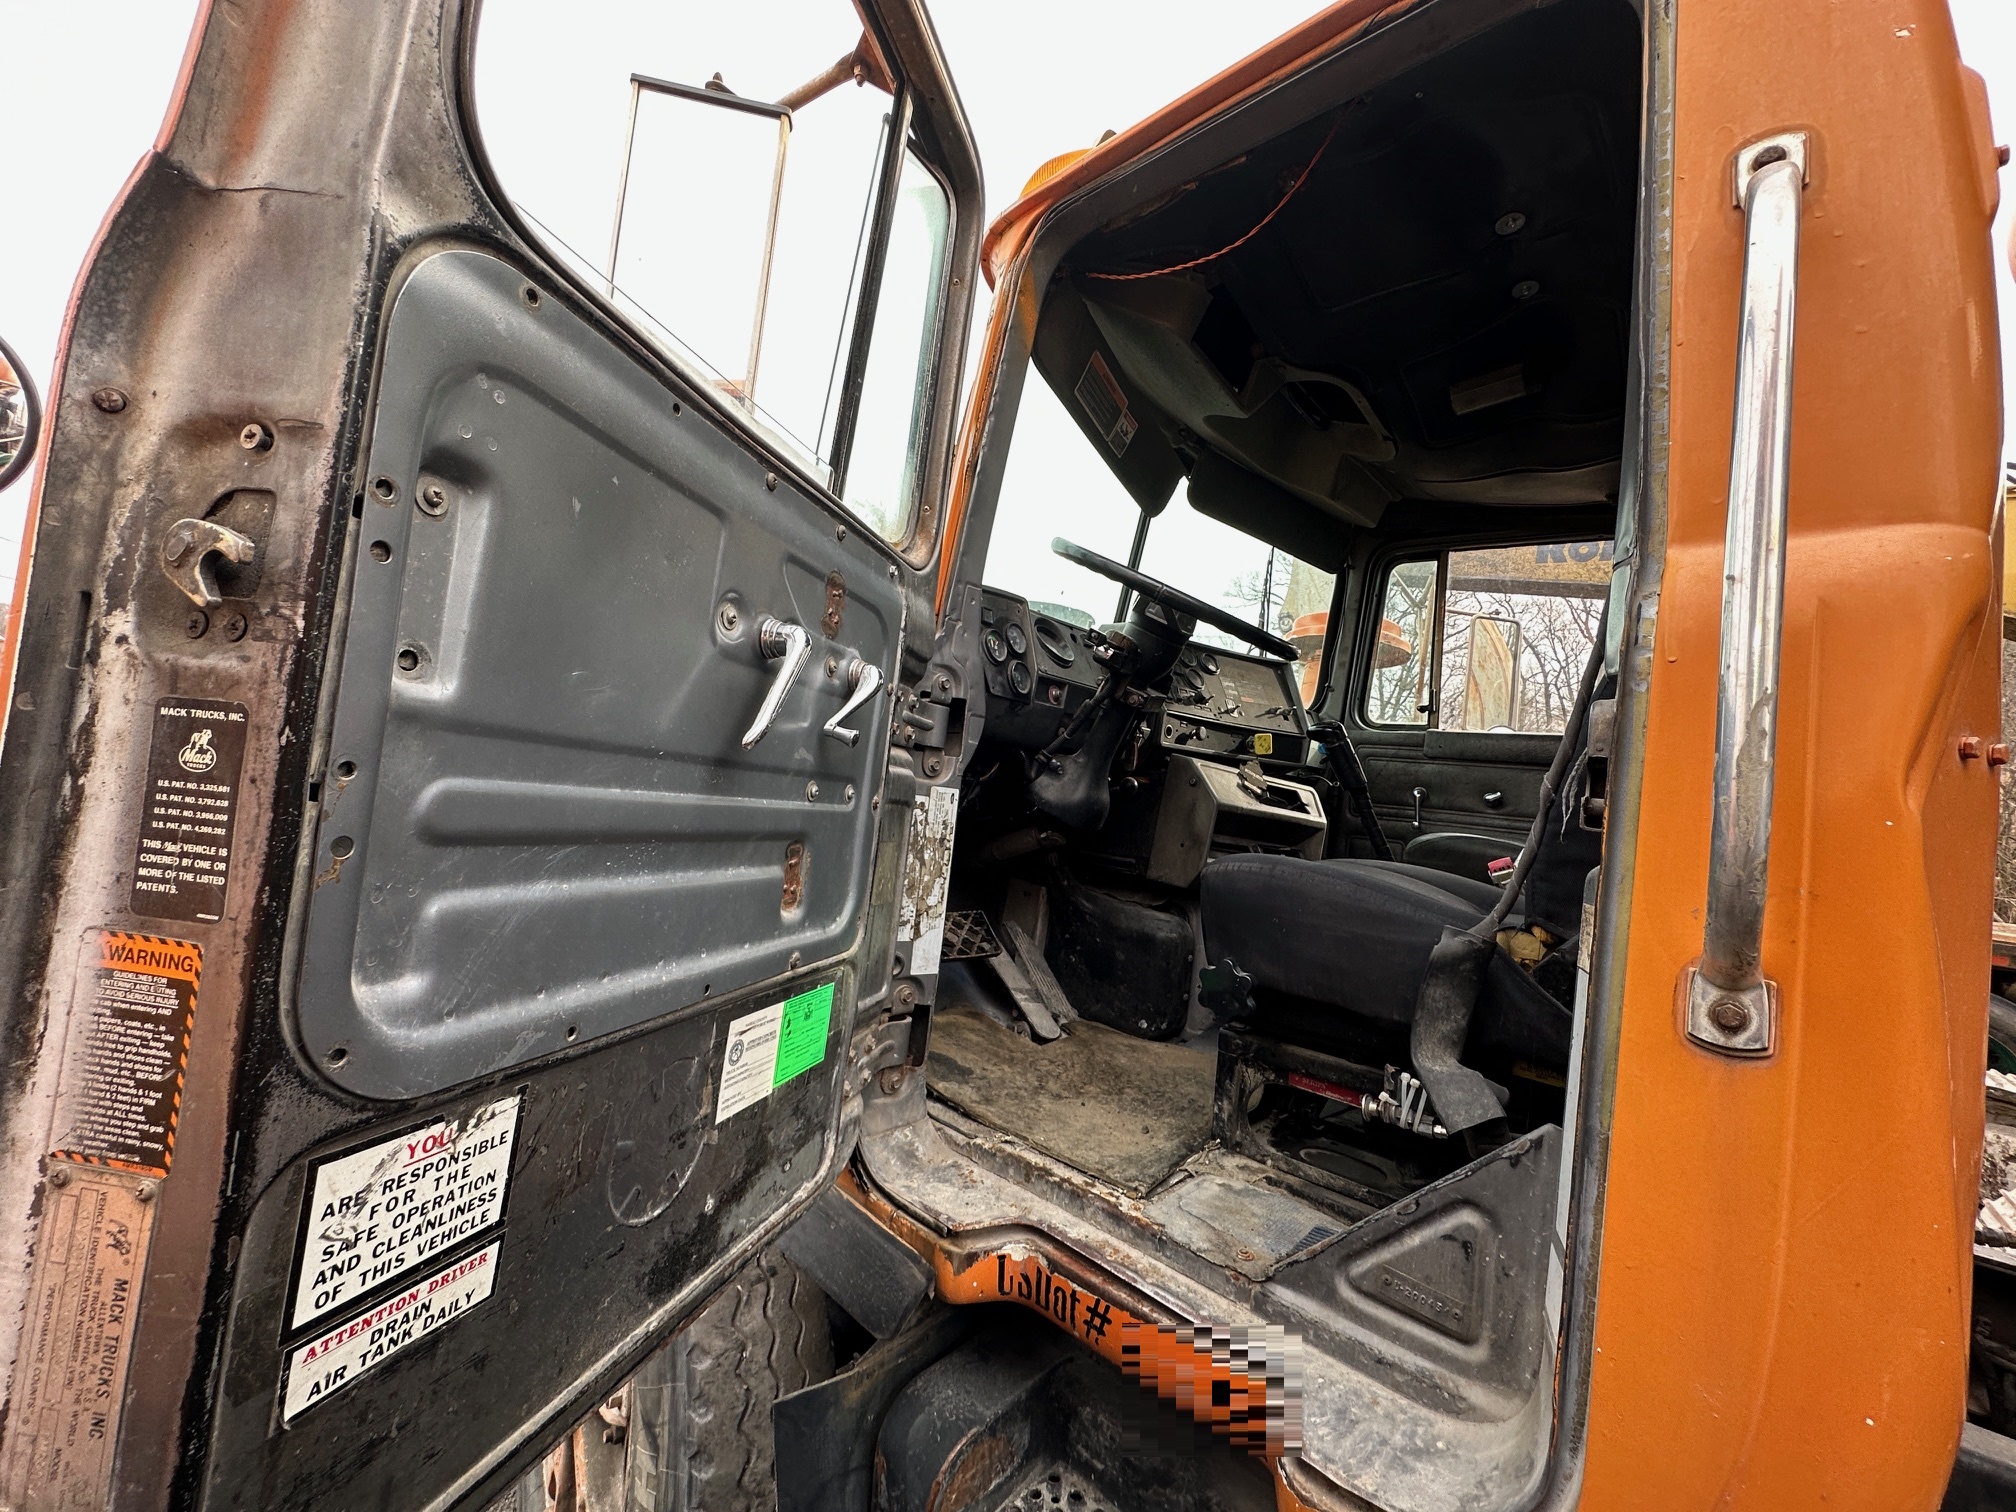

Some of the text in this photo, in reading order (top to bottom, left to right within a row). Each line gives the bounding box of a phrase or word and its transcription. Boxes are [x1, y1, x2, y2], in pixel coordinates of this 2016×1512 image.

[161, 707, 245, 721] MACK TRUCKS, INC.
[181, 749, 212, 764] Mack
[140, 853, 226, 871] COVERED BY ONE OR
[142, 839, 161, 849] THIS
[183, 844, 216, 855] VEHICLE
[219, 848, 228, 856] IS
[136, 882, 178, 894] PATENTS.
[138, 867, 225, 885] MORE OF THE LISTED
[109, 945, 193, 972] WARNING
[100, 978, 133, 989] ENTERING
[134, 983, 149, 991] AND
[152, 976, 167, 984] FOR
[104, 989, 125, 997] AVOID
[125, 992, 155, 1002] SERIOUS
[155, 997, 179, 1005] INJURY
[96, 1031, 118, 1040] AFTER
[98, 1023, 125, 1033] BEFORE
[113, 1110, 126, 1118] ALL
[406, 1128, 455, 1160] YOU
[320, 1129, 510, 1222] ARE RESPONSIBLE
[368, 1164, 472, 1221] FOR THE
[94, 1191, 109, 1233] VEHICLE
[320, 1169, 497, 1263] SAFE OPERATION
[311, 1188, 498, 1290] AND CLEANLINESS
[313, 1209, 491, 1311] OF THIS VEHICLE
[78, 1237, 100, 1317] IDENTIFICATION
[94, 1267, 105, 1286] THE
[88, 1290, 100, 1323] TRUCK
[107, 1278, 129, 1323] MACK
[302, 1252, 488, 1365] ATTENTION DRIVER
[369, 1297, 433, 1346] DRAIN
[71, 1320, 85, 1362] NUMBER
[306, 1287, 477, 1402] AIR TANK DAILY
